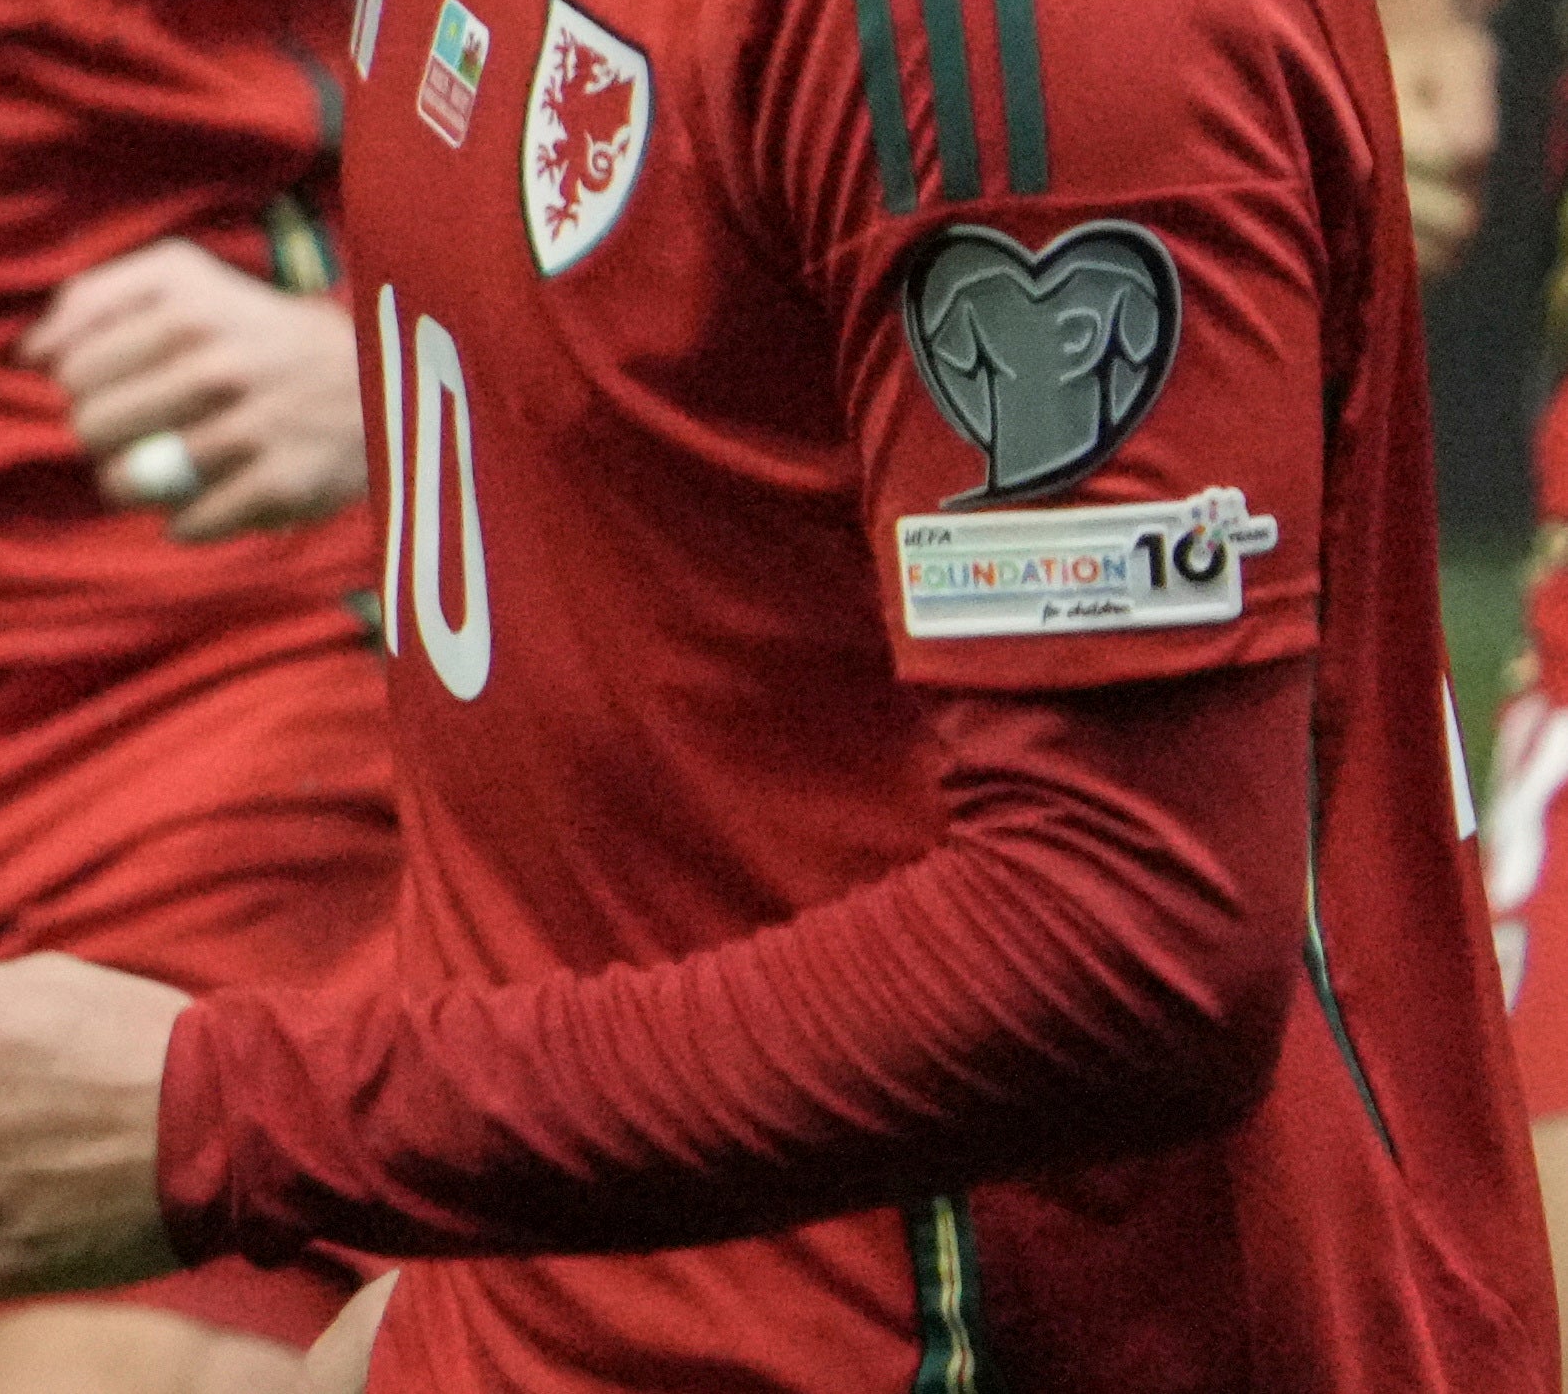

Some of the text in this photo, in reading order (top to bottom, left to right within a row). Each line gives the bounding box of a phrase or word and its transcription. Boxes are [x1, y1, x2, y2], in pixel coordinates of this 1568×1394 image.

[378, 283, 491, 702] 10
[909, 530, 1228, 593] FOUNDATION 10
